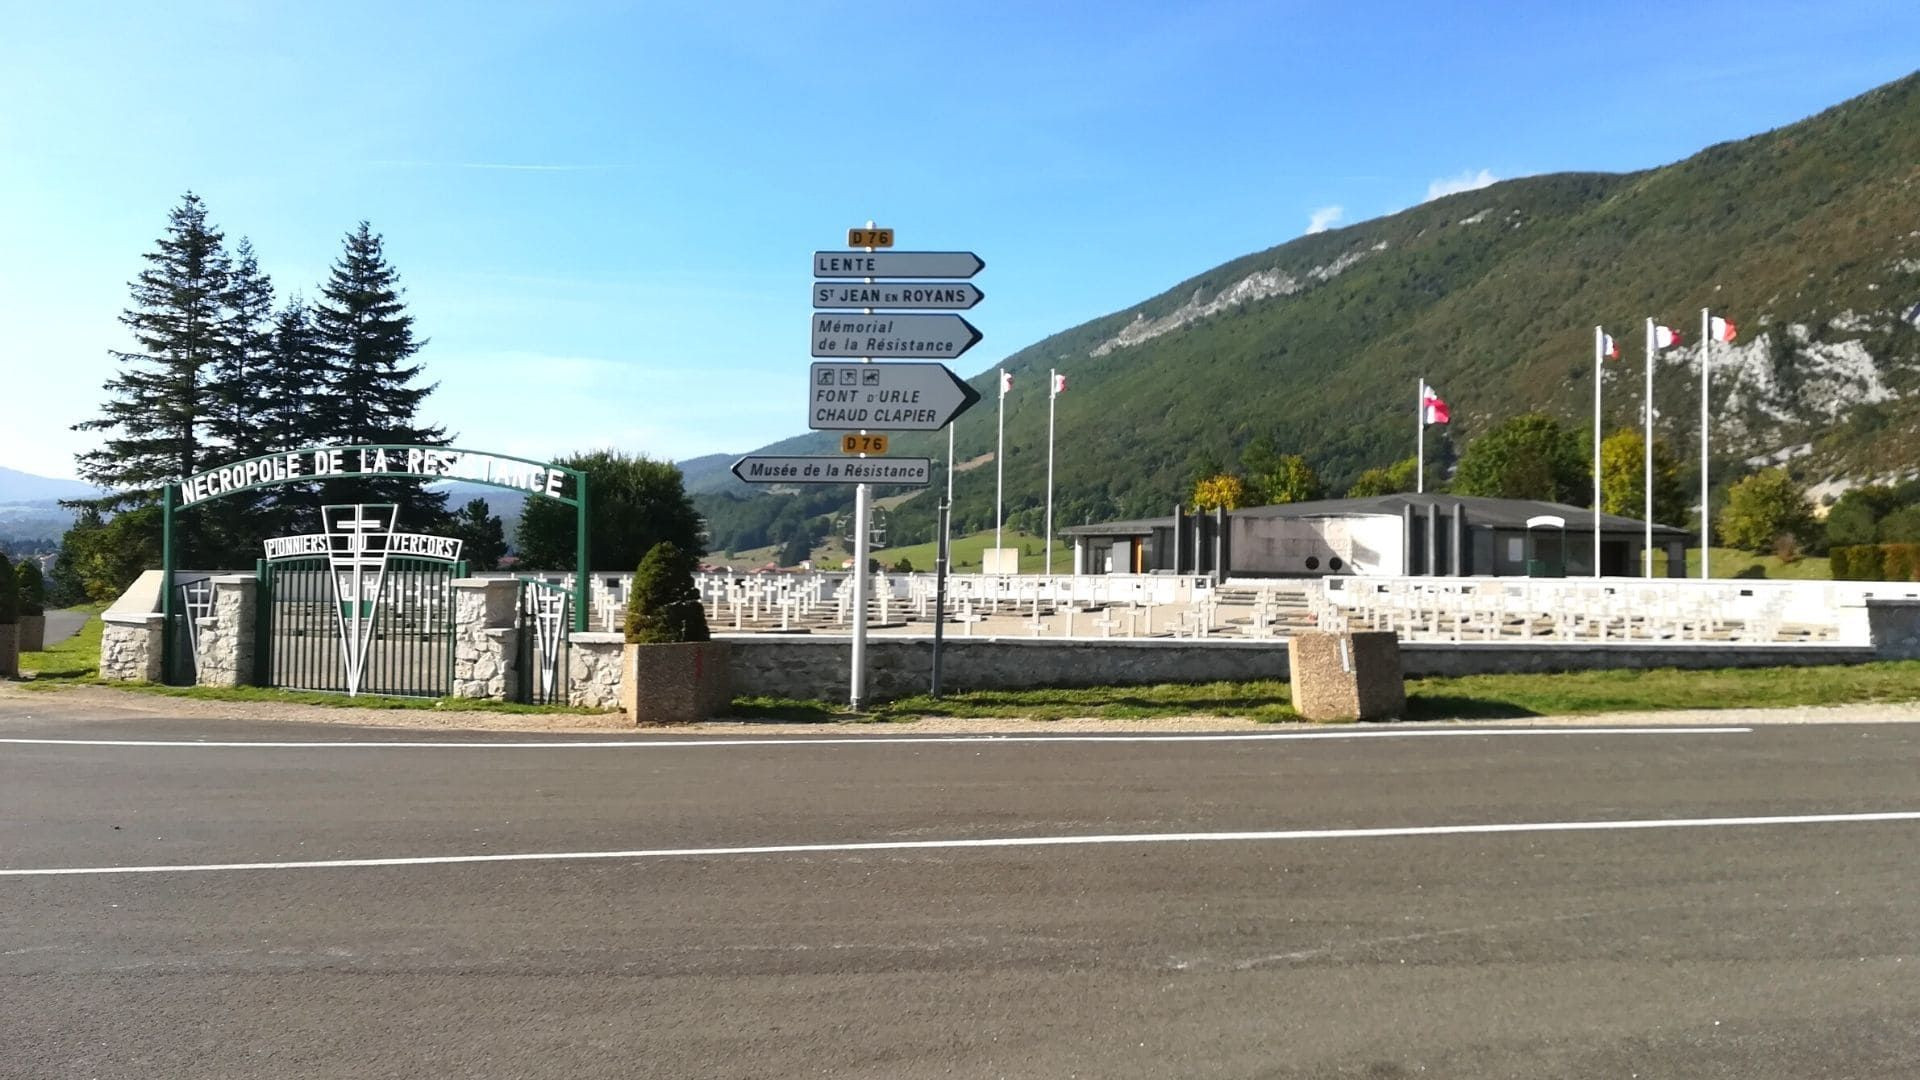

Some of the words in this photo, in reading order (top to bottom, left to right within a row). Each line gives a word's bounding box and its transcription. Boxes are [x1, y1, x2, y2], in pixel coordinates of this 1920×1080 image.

[853, 231, 862, 244] D
[868, 231, 889, 244] 76
[819, 258, 876, 271] LENTE
[840, 289, 880, 302] JEAN
[885, 293, 898, 302] EN
[903, 289, 965, 302] ROYANS
[818, 320, 893, 333] Mémorial
[818, 338, 836, 351] de
[844, 338, 858, 351] la
[866, 338, 954, 352] Résistance
[816, 390, 859, 403] FONT
[816, 409, 868, 422] CHAUD
[874, 409, 937, 423] CLAPIER
[846, 437, 856, 449] D
[862, 437, 882, 450] 76
[181, 453, 300, 505] NECROPOLE
[314, 449, 345, 476] DE
[360, 447, 388, 474] LA
[407, 447, 565, 499] RESTANCE
[750, 463, 798, 477] Musée
[803, 464, 821, 477] de
[825, 464, 839, 477] la
[844, 463, 924, 478] Résistance
[267, 535, 327, 557] PIONNIERS
[391, 534, 455, 557] VERCORS
